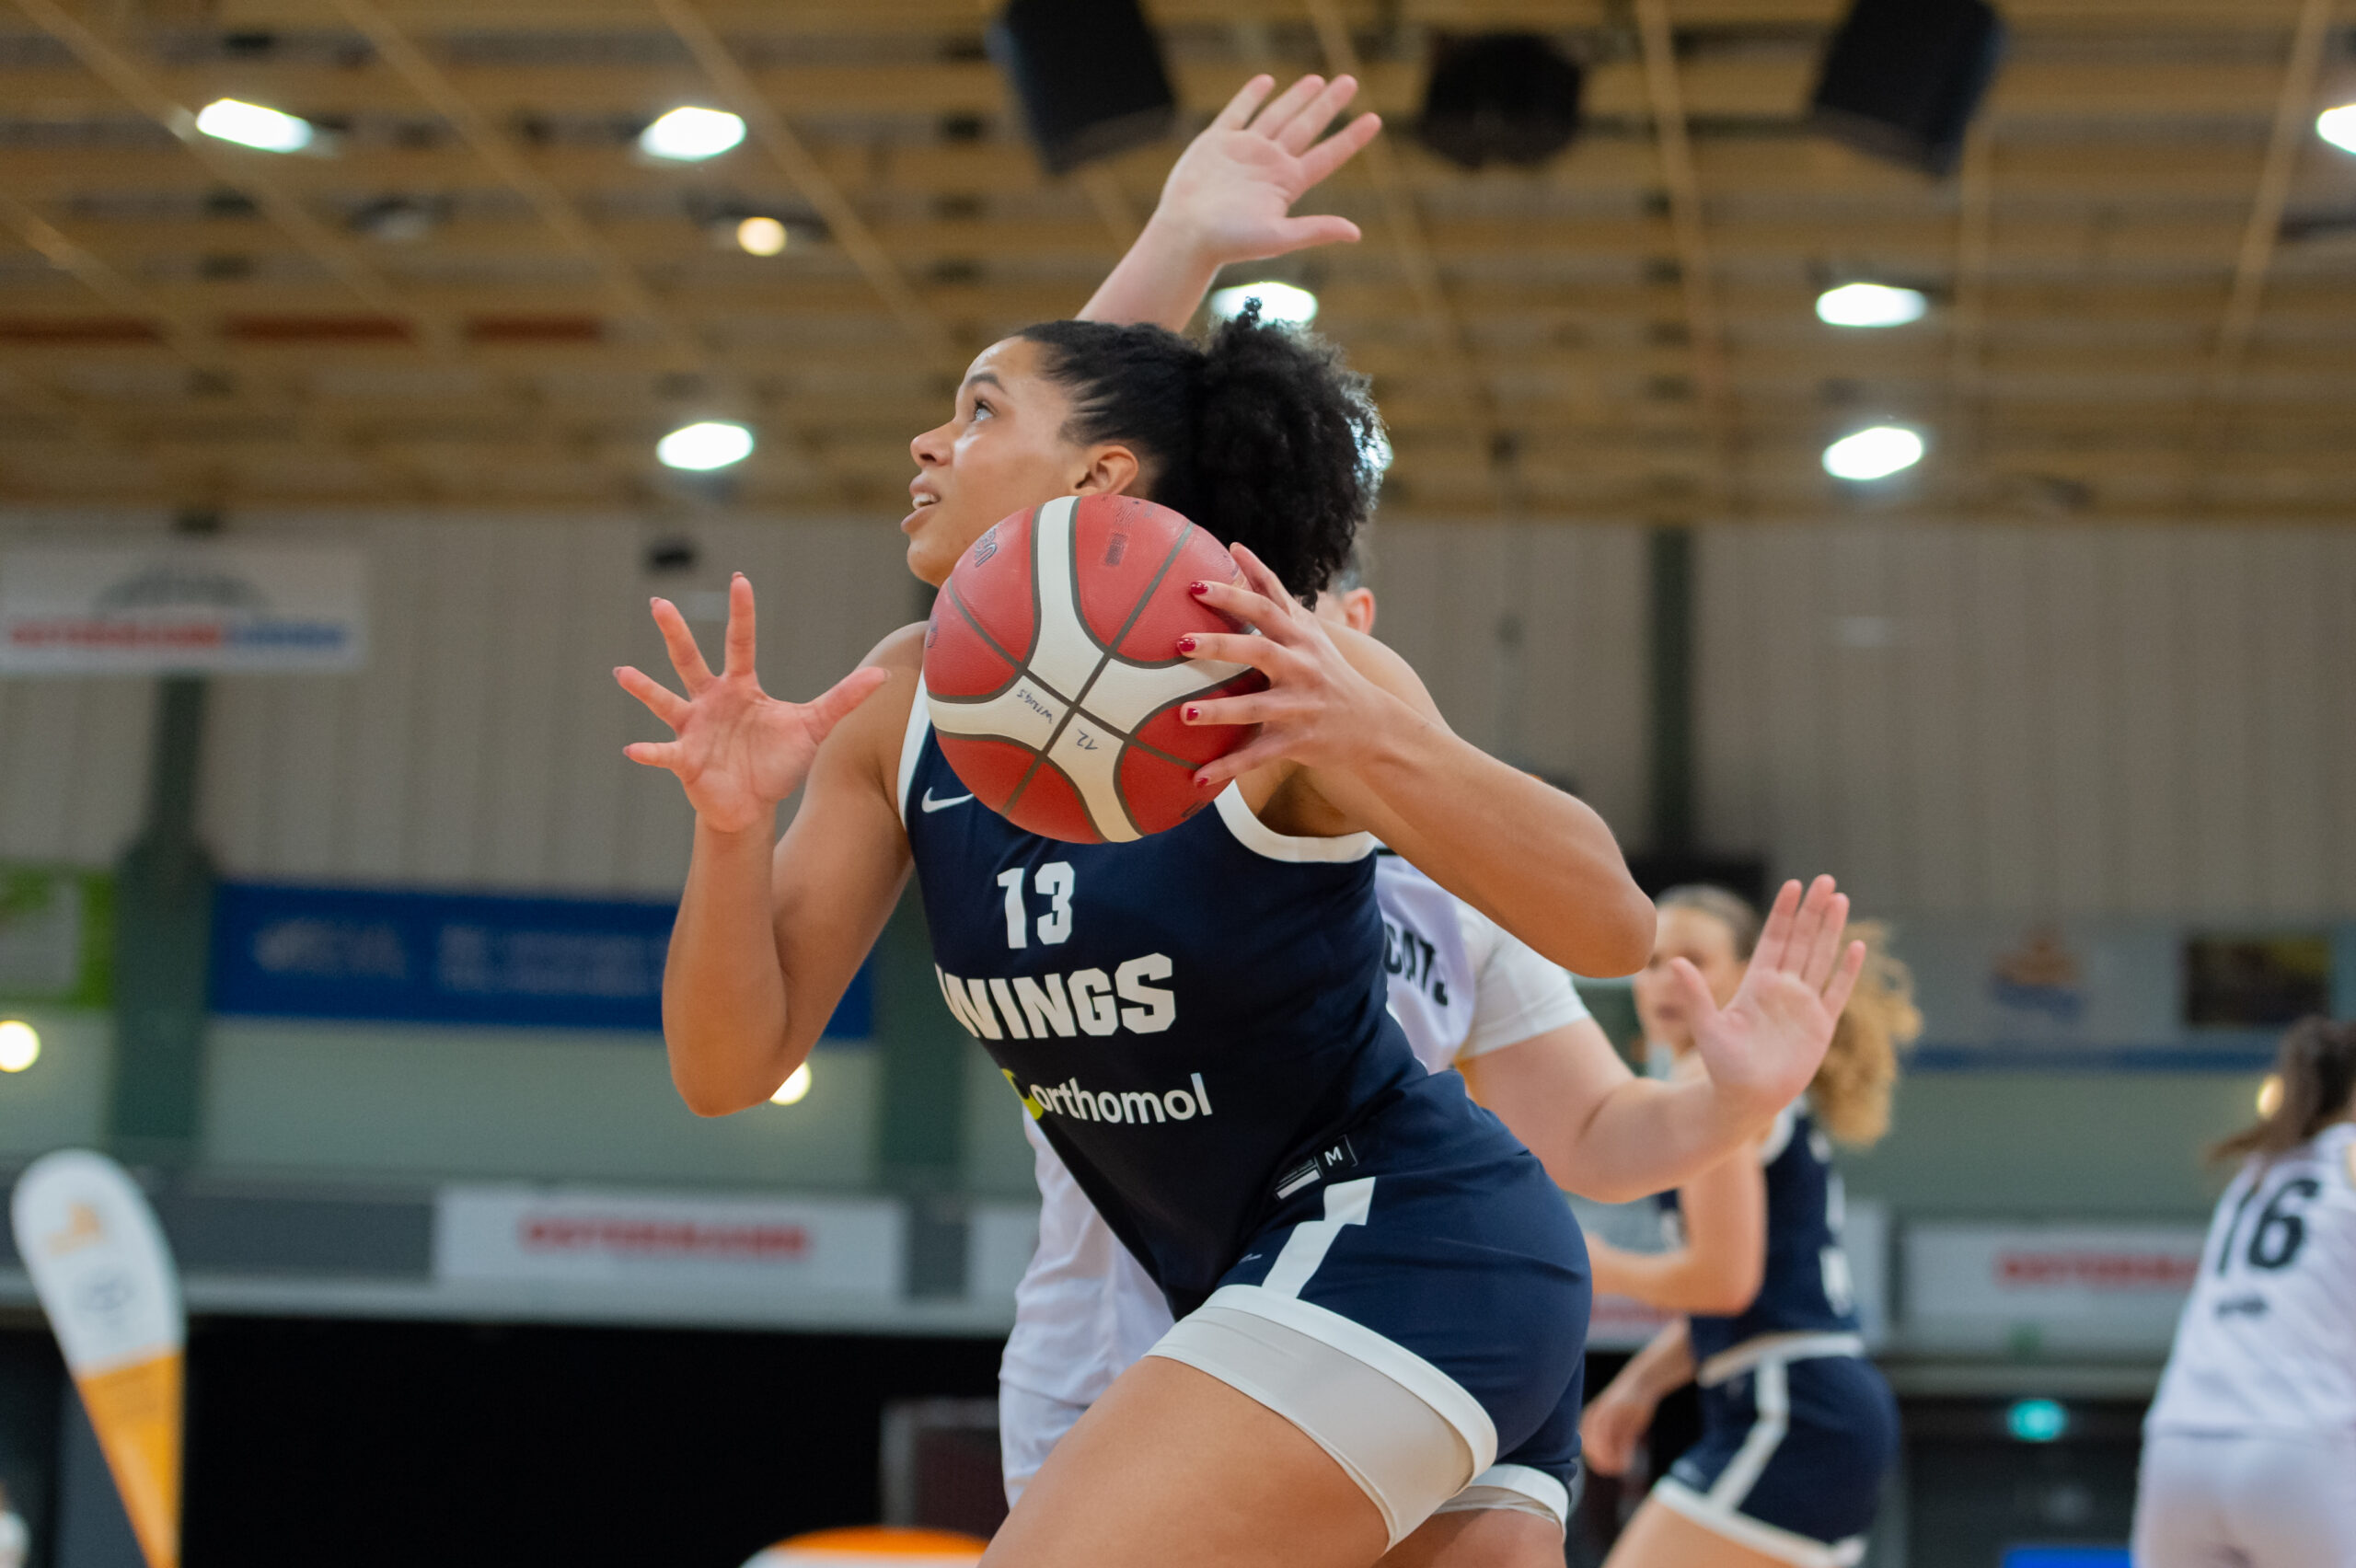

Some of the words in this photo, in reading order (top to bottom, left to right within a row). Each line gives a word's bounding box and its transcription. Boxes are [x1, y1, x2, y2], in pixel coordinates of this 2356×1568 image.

[1077, 728, 1099, 750] 12
[997, 860, 1075, 950] 13
[934, 952, 1176, 1040] WINGS
[1030, 1072, 1213, 1124] orthomol
[1324, 1146, 1343, 1167] M
[2217, 1179, 2322, 1277] 16
